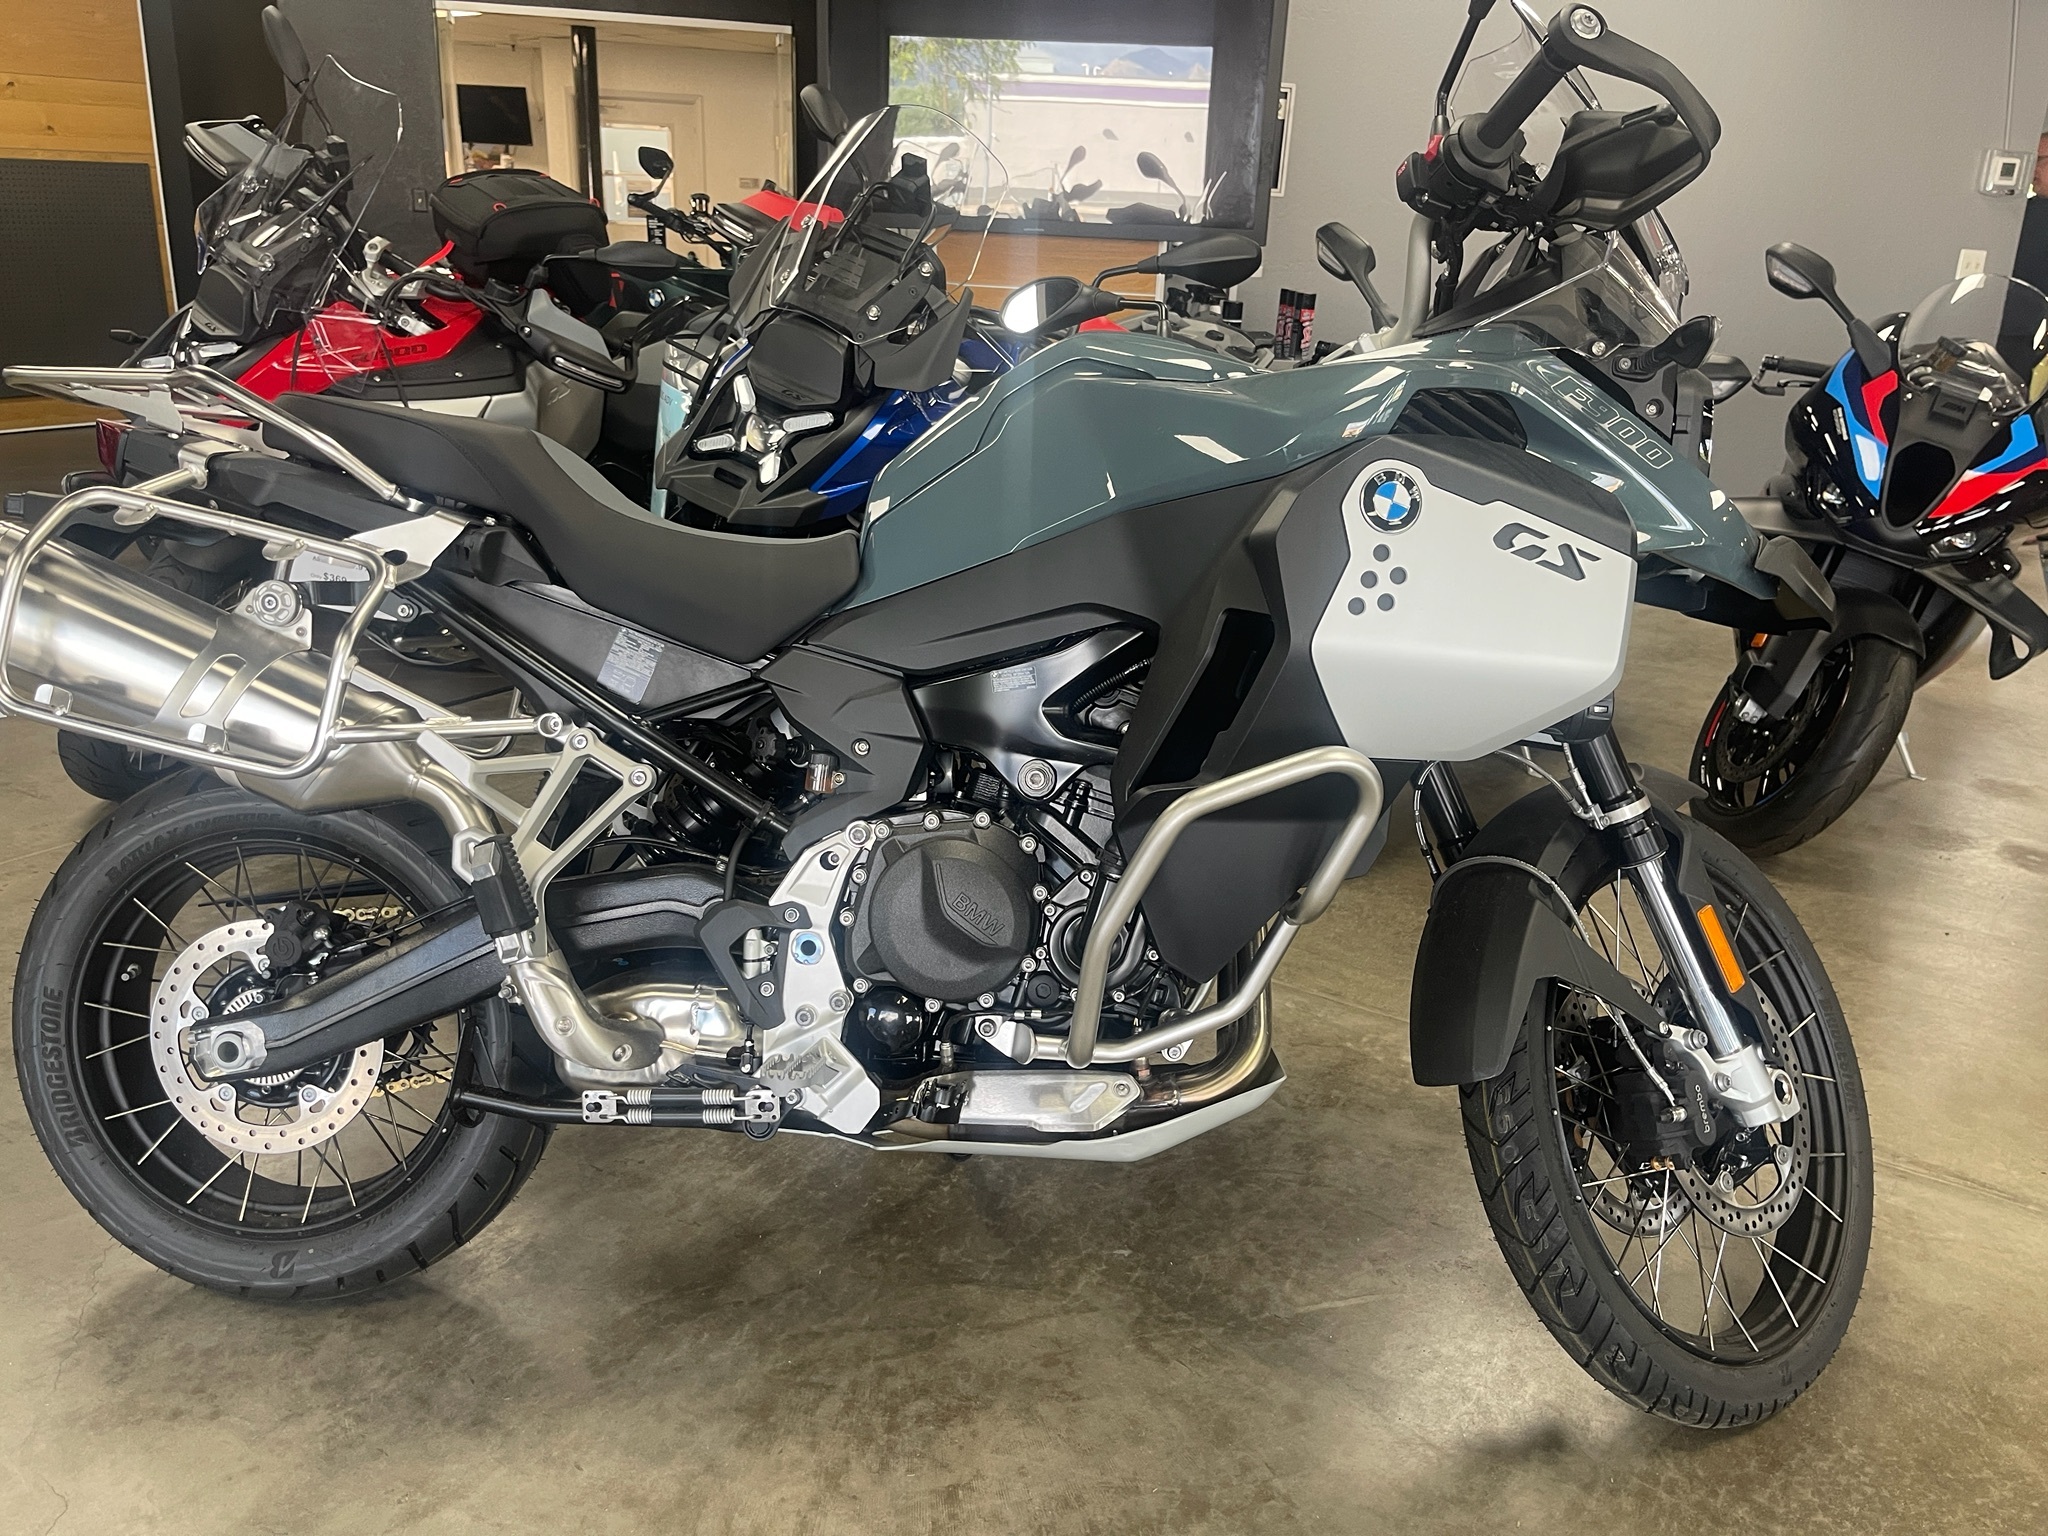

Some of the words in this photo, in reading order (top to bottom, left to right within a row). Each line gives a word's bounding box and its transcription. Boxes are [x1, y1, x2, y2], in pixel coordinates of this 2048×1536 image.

[1492, 522, 1602, 581] GS
[952, 891, 1006, 937] BMW
[41, 985, 93, 1148] BRIDGESTONE
[1695, 1084, 1711, 1134] brembo
